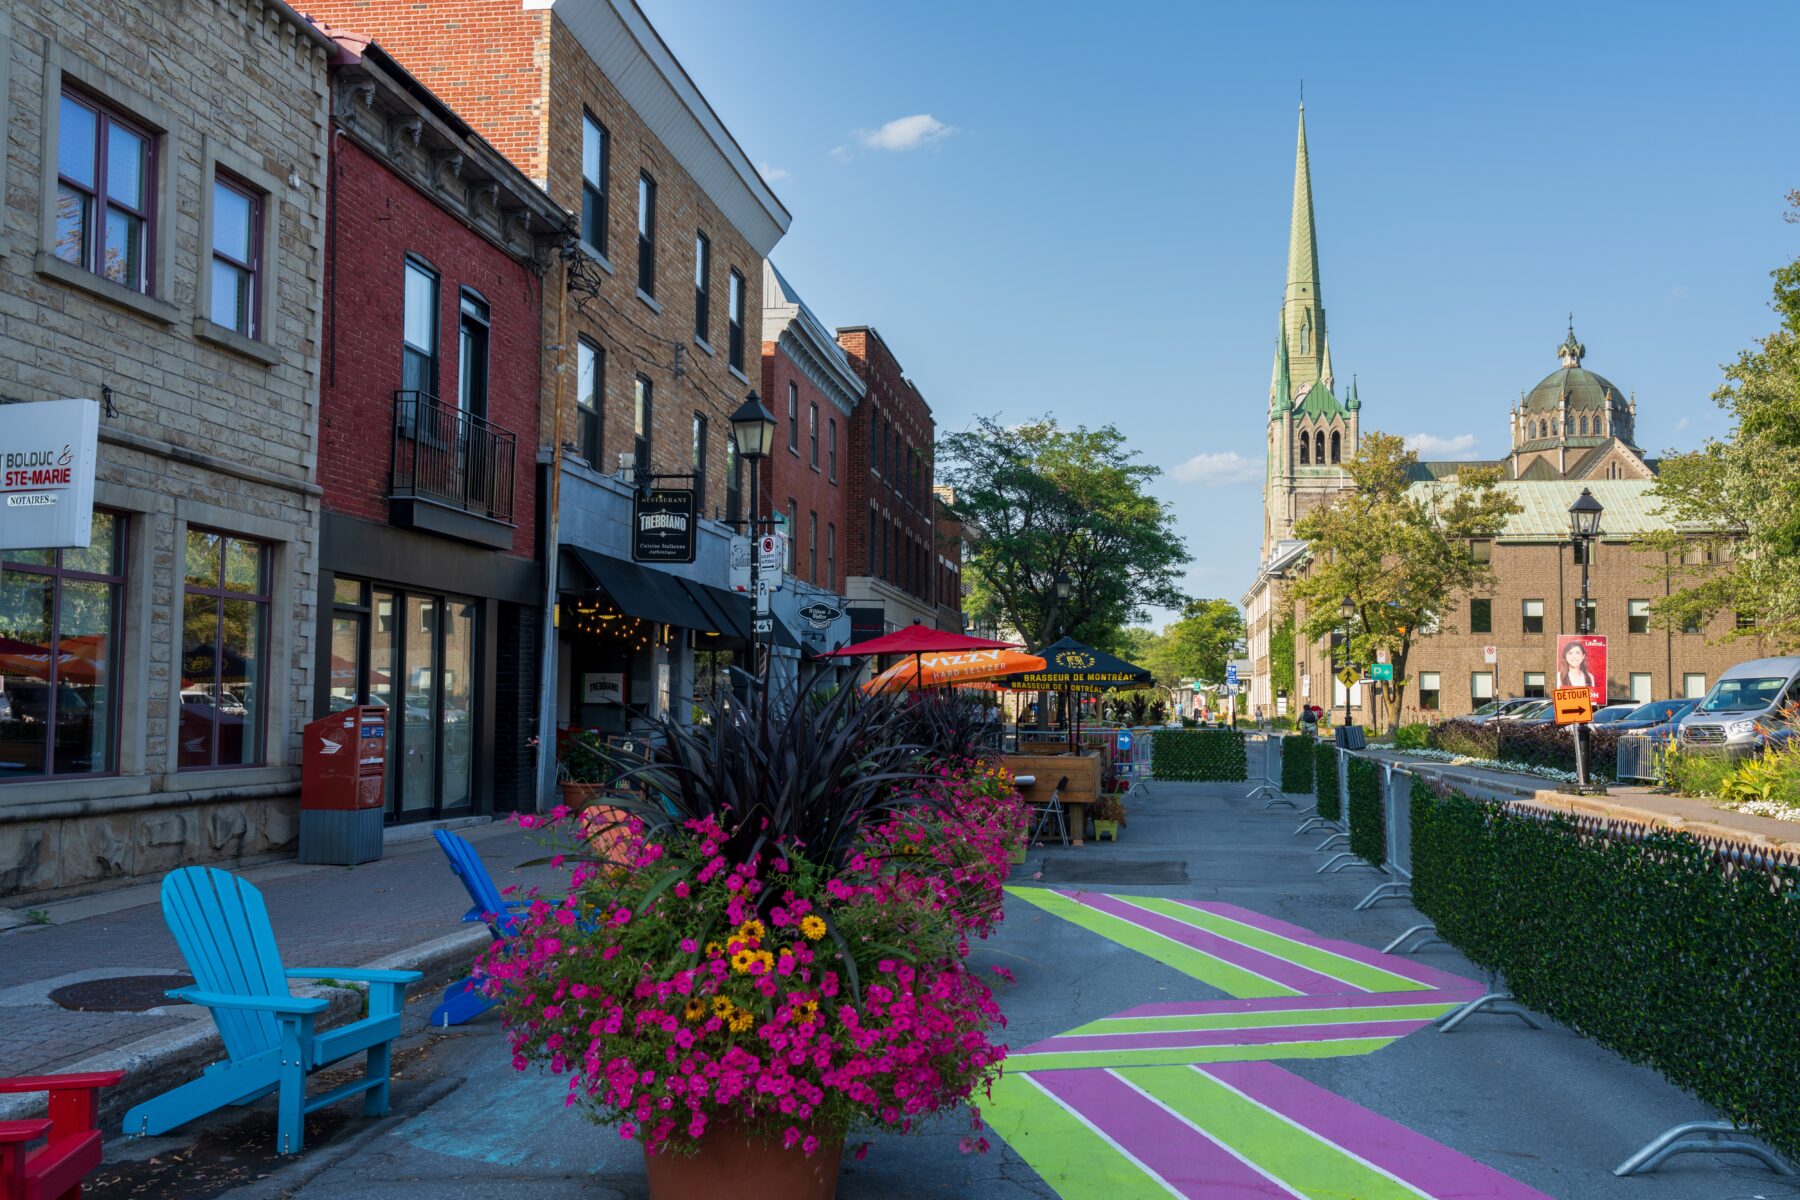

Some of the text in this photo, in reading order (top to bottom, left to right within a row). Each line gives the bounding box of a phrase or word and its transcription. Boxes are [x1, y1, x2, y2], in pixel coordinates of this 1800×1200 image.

[6, 444, 75, 468] BOLDUC &
[5, 468, 72, 487] STE-MARIE
[10, 495, 50, 506] NOTAIRES
[640, 514, 687, 532] TREBBIANO
[920, 649, 1000, 668] VIZZY
[933, 663, 1006, 679] HARD SELTZER
[1024, 674, 1070, 682] BRASSEUR
[1087, 672, 1133, 681] MONTRÉAL
[1373, 667, 1382, 677] P
[590, 681, 619, 692] TREBBIANO
[1012, 682, 1050, 690] BRASSEUR
